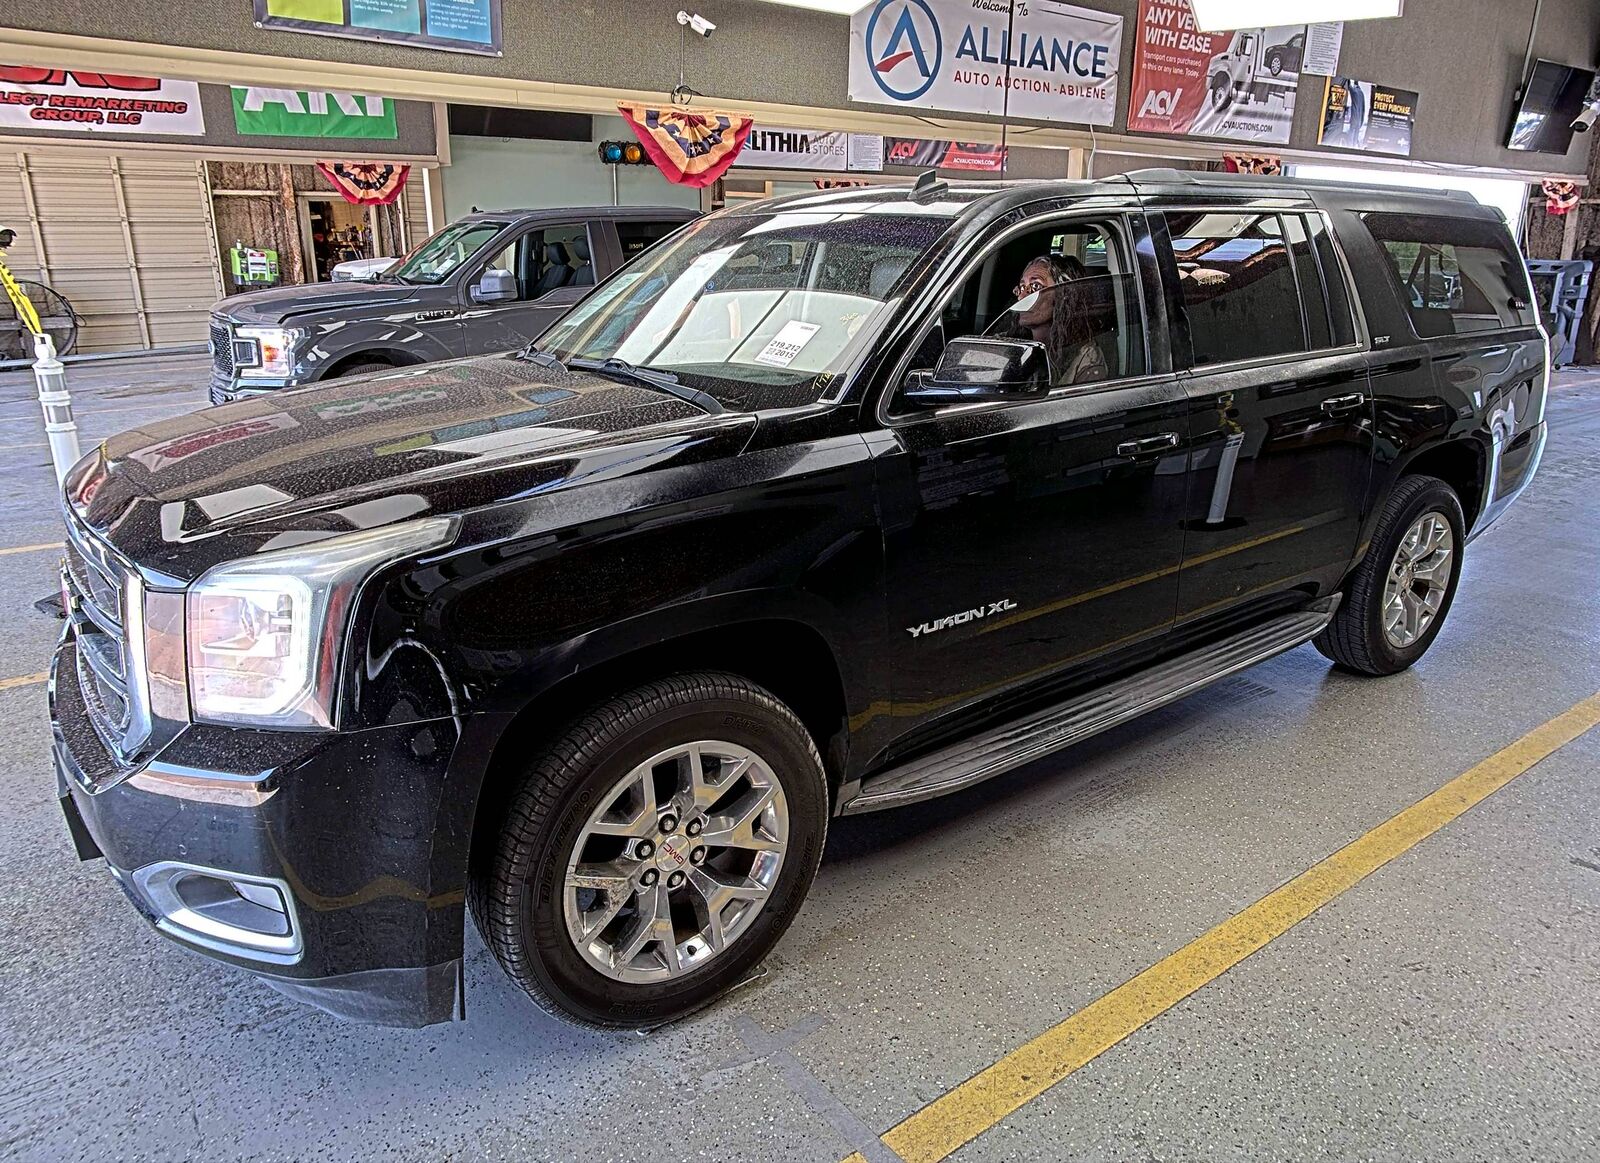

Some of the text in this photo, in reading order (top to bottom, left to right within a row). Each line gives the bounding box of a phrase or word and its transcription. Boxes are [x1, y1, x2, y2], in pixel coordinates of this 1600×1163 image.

[1017, 3, 1029, 17] To
[1145, 6, 1175, 27] ANY
[1145, 26, 1212, 54] WITH EASE.
[955, 24, 1109, 79] ALLIANCE
[1143, 50, 1166, 62] Transport
[1177, 57, 1202, 67] purchased
[954, 70, 990, 86] AUTO
[995, 75, 1050, 93] AUCTION
[1059, 84, 1106, 100] ABILENE
[49, 94, 188, 114] REMARKETING
[1137, 88, 1183, 118] ACV
[30, 108, 142, 125] GROUP, LLC
[1222, 120, 1273, 133] CVAUCTIONS.COM
[751, 129, 812, 154] LITHIA
[812, 145, 846, 157] STORES
[774, 349, 796, 360] 2015
[906, 598, 1018, 638] YUKON XL
[662, 842, 685, 865] GMC
